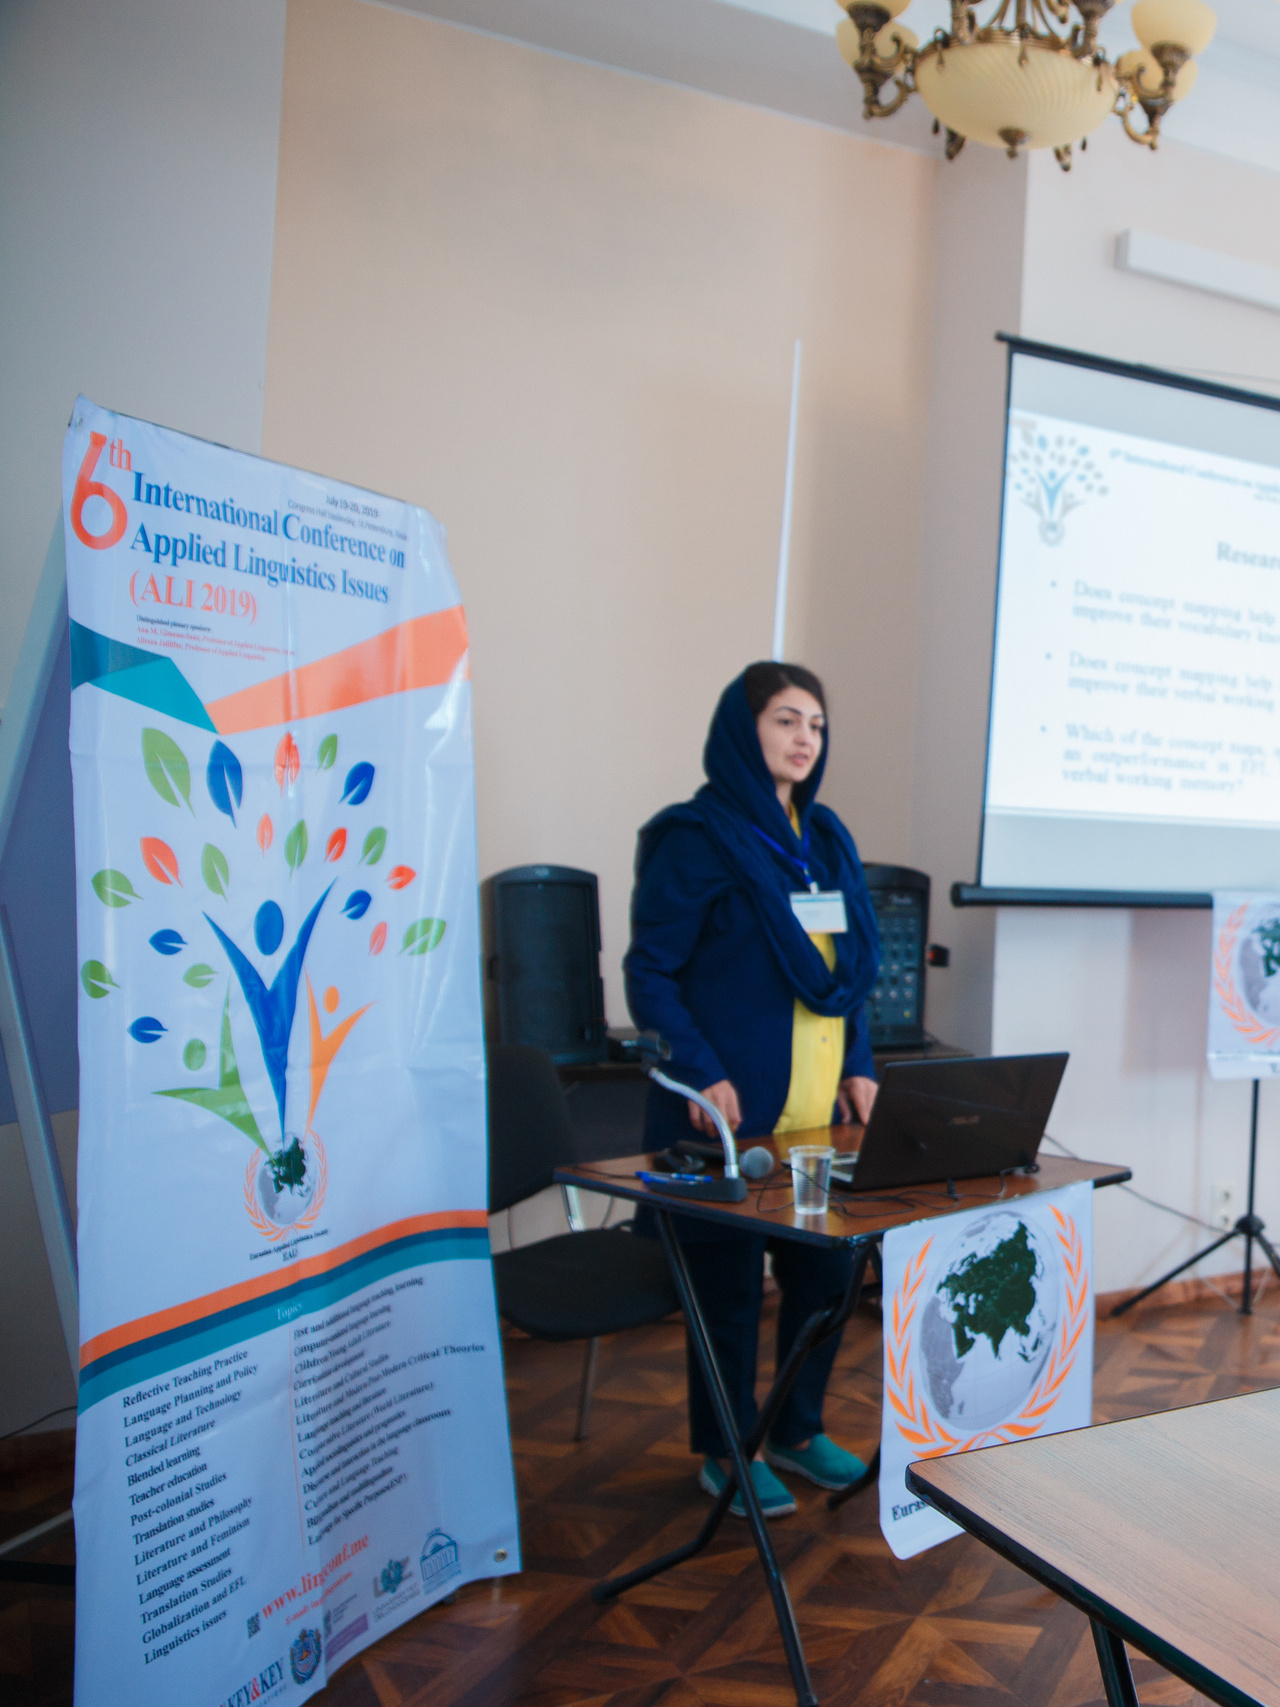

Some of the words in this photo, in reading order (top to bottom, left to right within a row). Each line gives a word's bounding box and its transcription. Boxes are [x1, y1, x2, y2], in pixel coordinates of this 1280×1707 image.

[132, 470, 279, 537] International
[281, 513, 386, 562] Conference
[389, 547, 405, 569] on
[287, 499, 315, 515] Congress
[326, 494, 339, 508] July
[361, 504, 380, 519] 2019
[130, 522, 227, 568] Applied
[233, 543, 336, 592] Linguistics
[341, 567, 389, 604] Issues
[129, 569, 194, 609] (ALI
[201, 581, 258, 626] 2019)
[1073, 604, 1133, 624] improve
[1141, 611, 1172, 629] their
[1074, 579, 1112, 600] Does
[1119, 591, 1175, 613] concept
[1182, 601, 1241, 623] mapping
[1070, 650, 1107, 670] Does
[1115, 661, 1171, 682] concept
[1178, 669, 1238, 690] mapping
[1068, 676, 1128, 695] improve
[1136, 680, 1168, 698] their
[1222, 693, 1274, 713] working
[1063, 748, 1081, 762] an
[1092, 751, 1206, 772] outperformance
[1066, 722, 1114, 743] Which
[1120, 728, 1139, 744] of
[1142, 729, 1162, 747] the
[1168, 737, 1222, 755] concept
[1062, 767, 1108, 783] verbal
[1115, 773, 1172, 791] working
[277, 1301, 304, 1320] Topics
[122, 1382, 170, 1408] Reflective
[172, 1365, 212, 1388] Teaching
[213, 1350, 248, 1371] Practice
[408, 1348, 440, 1368] Critical
[441, 1343, 486, 1358] Theories
[123, 1402, 172, 1428] Language
[173, 1384, 214, 1407] Planning
[215, 1373, 232, 1389] and
[233, 1364, 258, 1381] Policy
[124, 1421, 173, 1448] Language
[175, 1410, 193, 1426] and
[195, 1389, 242, 1417] Technology
[125, 1439, 168, 1467] Classical
[170, 1420, 216, 1447] Literature
[127, 1461, 164, 1487] Blended
[165, 1445, 201, 1469] learning
[129, 1482, 166, 1506] Teacher
[166, 1462, 207, 1489] education
[130, 1487, 194, 1526] Post-colonial
[195, 1472, 227, 1495] Studies
[133, 1513, 185, 1545] Translation
[185, 1498, 215, 1519] studies
[134, 1533, 186, 1567] Literature
[188, 1520, 206, 1538] and
[207, 1497, 253, 1527] Philosophy
[891, 1500, 926, 1522] Euras
[136, 1552, 188, 1586] Literature
[190, 1538, 209, 1557] and
[210, 1517, 251, 1546] Feminism
[138, 1574, 185, 1605] Language
[186, 1546, 231, 1580] assessment
[140, 1586, 199, 1625] Translation
[200, 1566, 232, 1592] Studies
[142, 1600, 210, 1644] Globalization
[211, 1586, 228, 1605] and
[228, 1574, 246, 1594] EFL
[144, 1625, 201, 1665] Linguistics
[201, 1608, 227, 1632] issues
